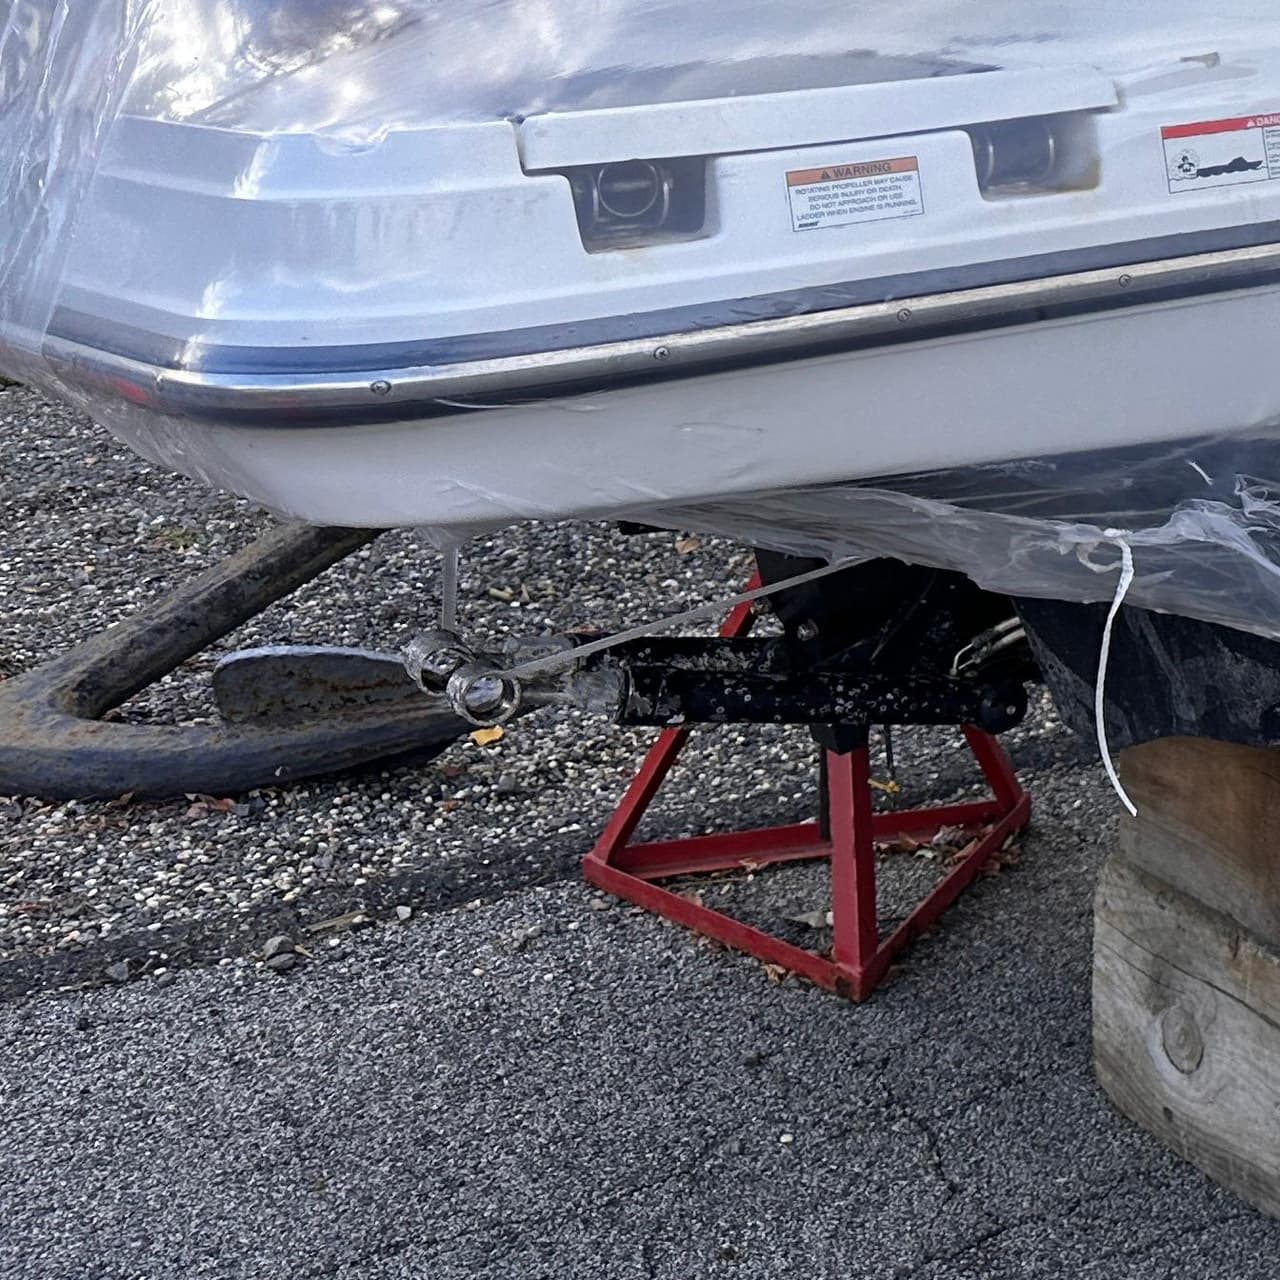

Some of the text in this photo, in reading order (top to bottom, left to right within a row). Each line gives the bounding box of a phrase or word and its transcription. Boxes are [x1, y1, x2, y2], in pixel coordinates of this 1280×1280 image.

[833, 162, 892, 179] WARNING
[795, 175, 913, 196] ROTATING PROPELLER MAY CAUSE
[808, 193, 839, 203] SERIOUS
[841, 189, 865, 199] INJURY
[866, 187, 878, 195] OR
[809, 192, 904, 211] DO NOT APPROACH OR USE
[796, 211, 826, 221] LADDER
[826, 208, 849, 217] WHEN
[849, 204, 876, 214] ENGINE
